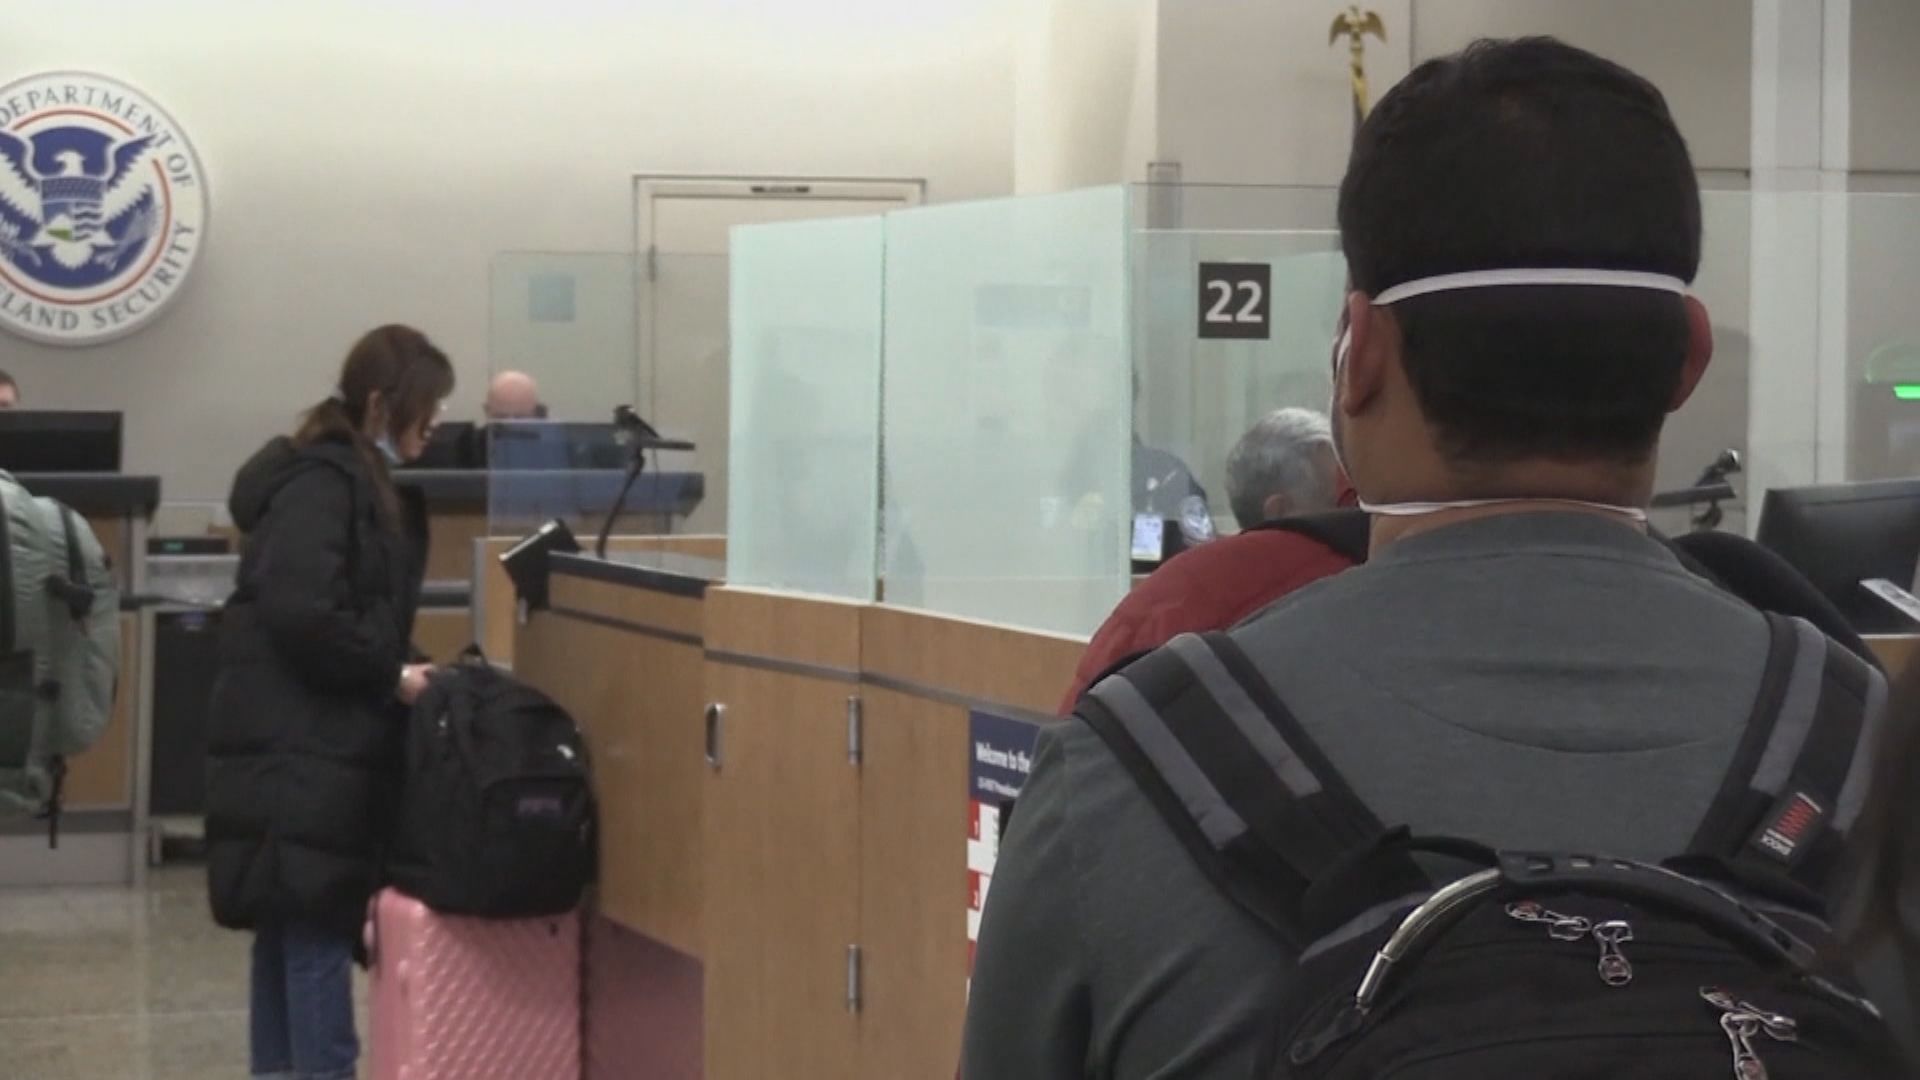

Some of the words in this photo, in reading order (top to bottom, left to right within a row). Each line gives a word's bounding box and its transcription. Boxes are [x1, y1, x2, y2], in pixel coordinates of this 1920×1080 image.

[166, 153, 194, 188] OF
[0, 284, 80, 331] LAND
[92, 222, 195, 329] SECURITY
[1205, 279, 1263, 323] 22
